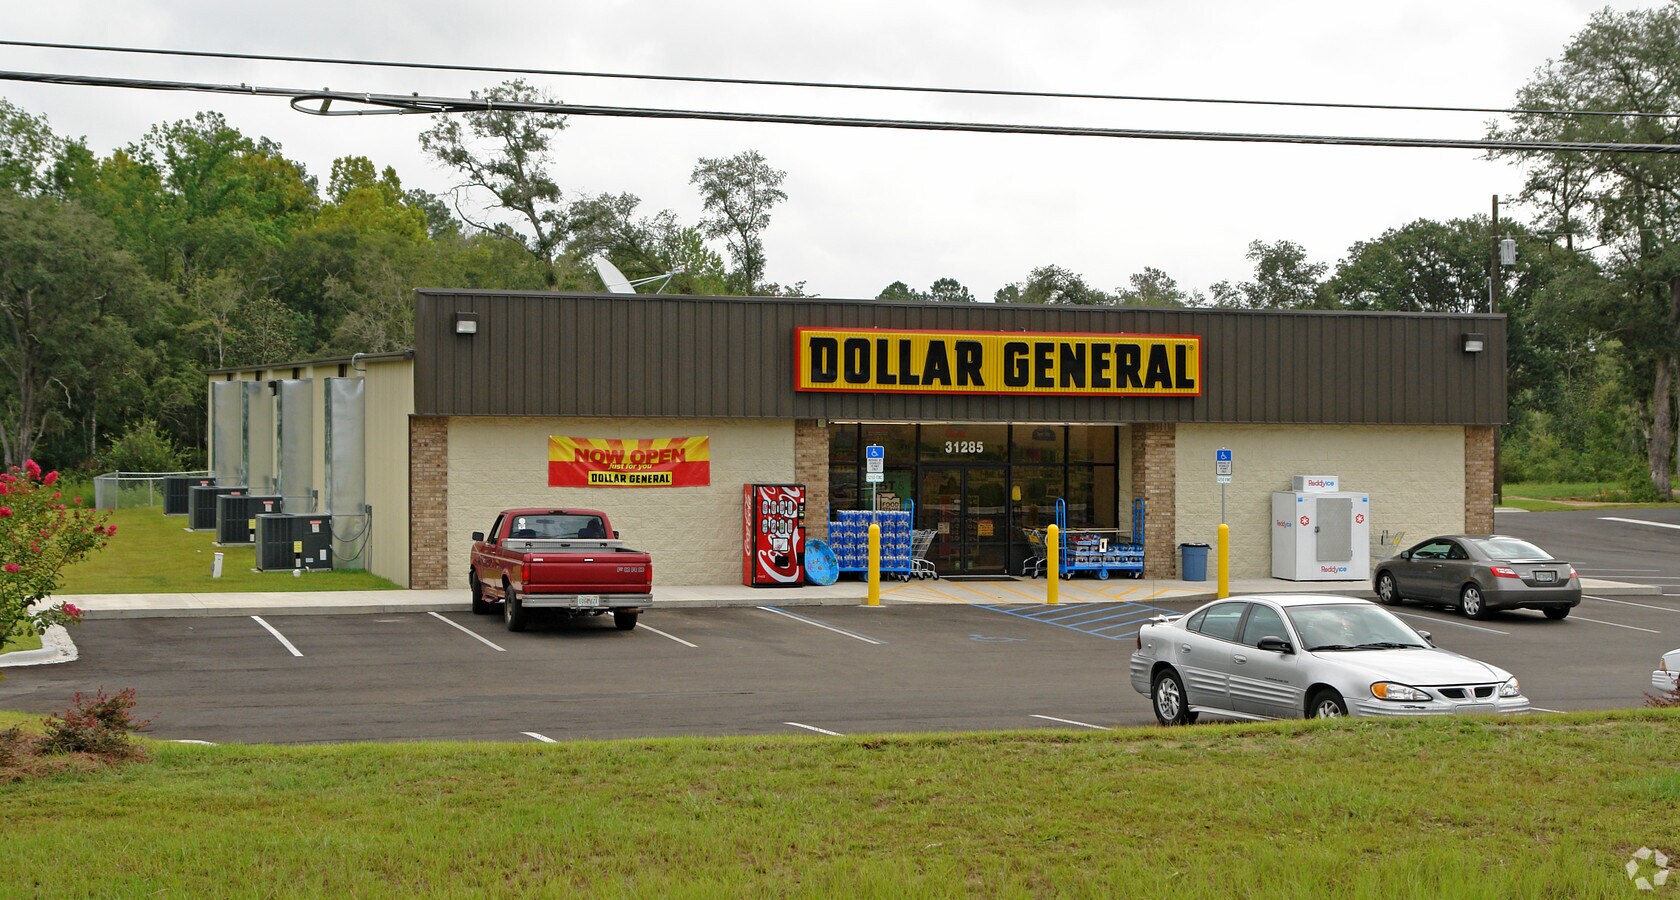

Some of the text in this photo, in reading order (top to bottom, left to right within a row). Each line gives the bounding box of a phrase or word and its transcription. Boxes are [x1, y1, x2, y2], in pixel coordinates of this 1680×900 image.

[809, 337, 1195, 389] DOLLAR GENERAL
[945, 441, 984, 454] 31285
[574, 448, 685, 464] NOW OPEN
[592, 473, 670, 483] DOLLAR GENERAL
